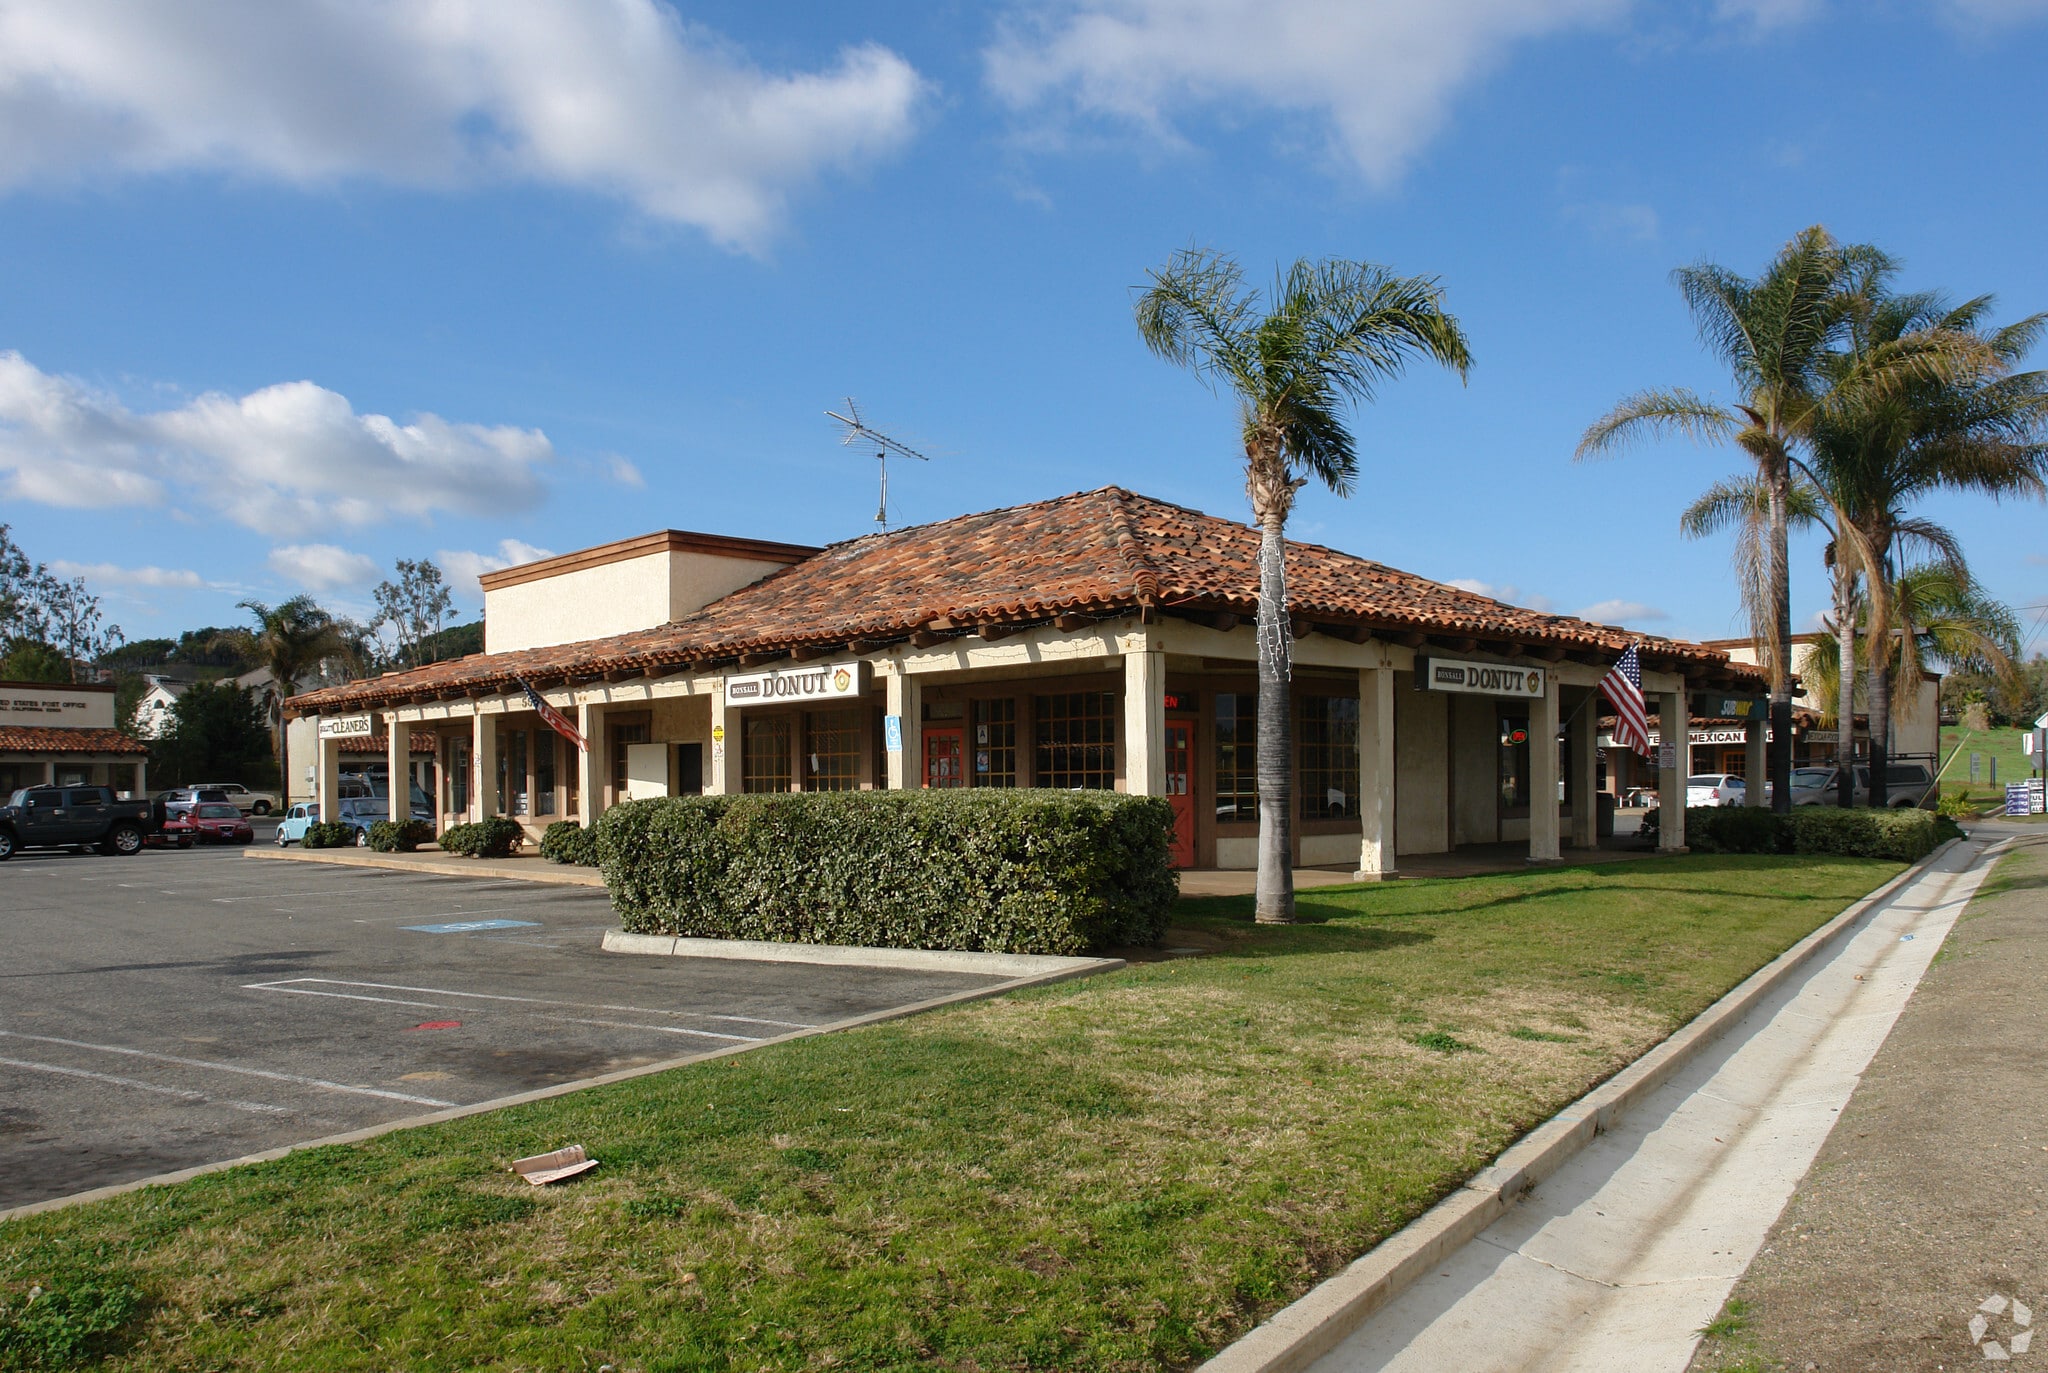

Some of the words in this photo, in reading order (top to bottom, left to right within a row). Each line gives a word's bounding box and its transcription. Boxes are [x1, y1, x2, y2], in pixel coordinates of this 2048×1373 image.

[732, 685, 758, 695] BONSALL
[763, 672, 829, 698] DONUT
[1437, 670, 1463, 681] BONSALL
[1467, 667, 1524, 691] DONUT
[1164, 695, 1178, 708] EN
[1720, 699, 1753, 716] SUBWAY
[332, 719, 369, 734] CLEANERS
[1689, 732, 1741, 743] MEXICAN
